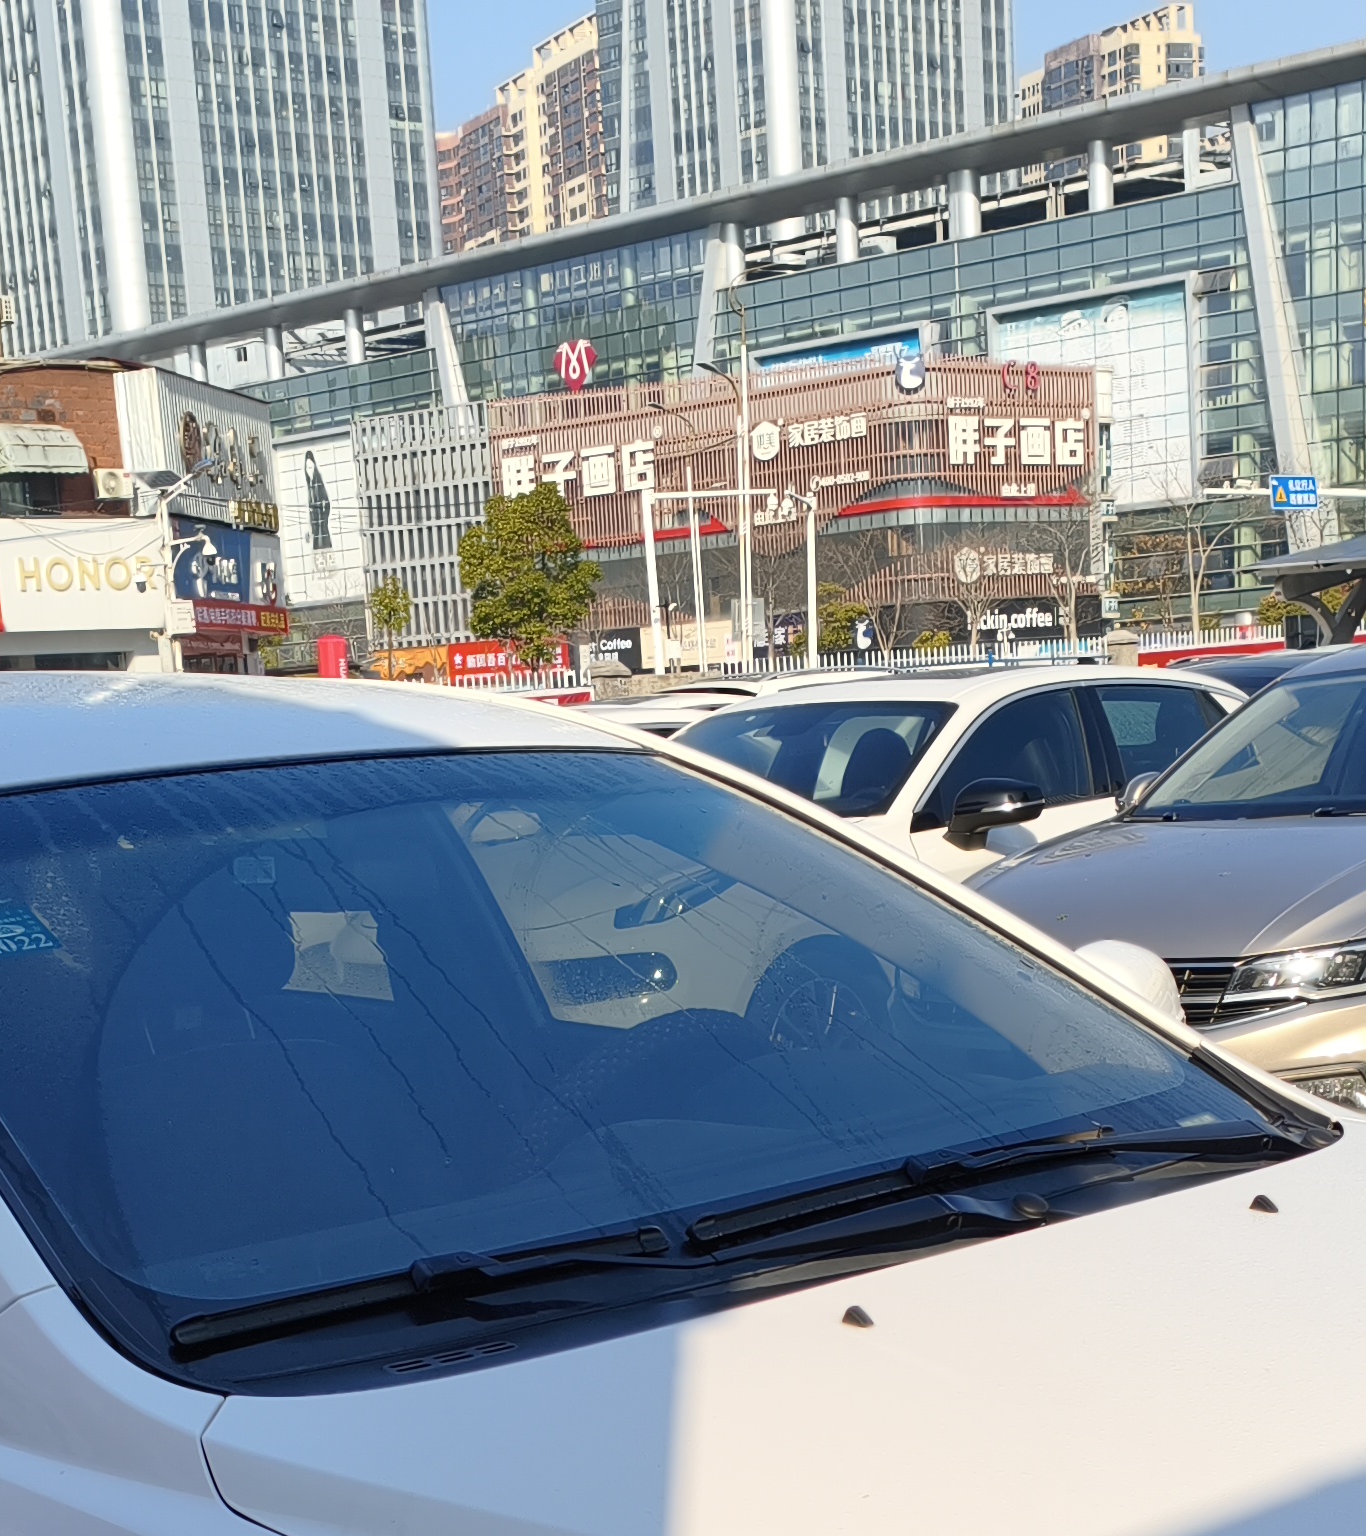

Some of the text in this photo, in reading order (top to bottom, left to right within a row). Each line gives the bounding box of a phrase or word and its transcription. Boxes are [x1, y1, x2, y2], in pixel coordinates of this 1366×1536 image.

[788, 412, 867, 448] 家居装饰画
[948, 416, 1084, 466] 胖子画店
[502, 440, 655, 499] 胖子画店
[16, 554, 158, 592] HONOR
[1011, 608, 1053, 628] coffee
[600, 638, 633, 651] Coffee
